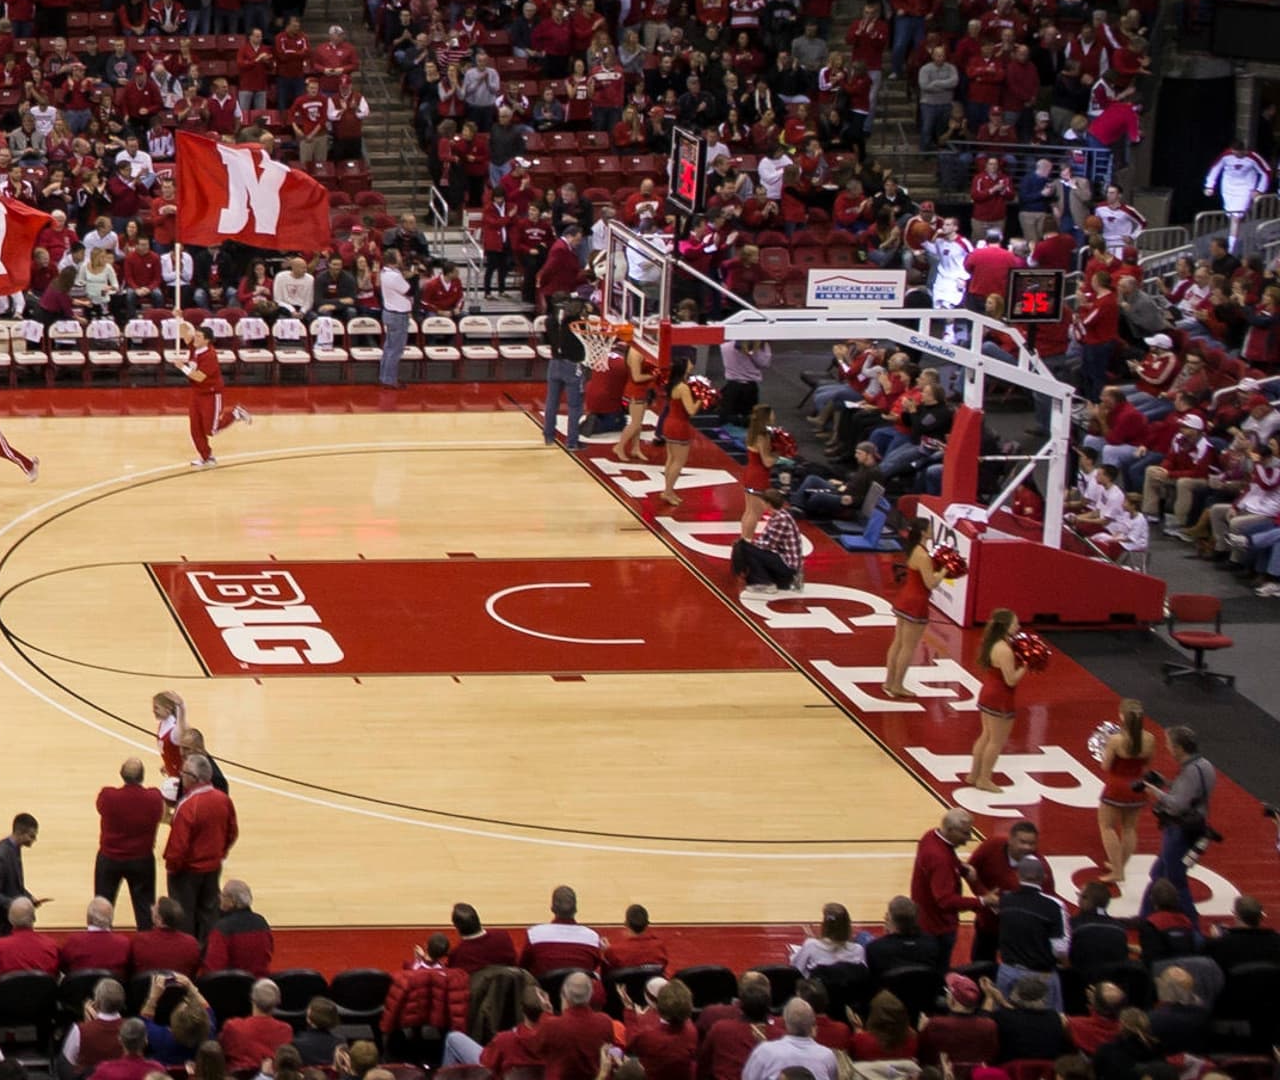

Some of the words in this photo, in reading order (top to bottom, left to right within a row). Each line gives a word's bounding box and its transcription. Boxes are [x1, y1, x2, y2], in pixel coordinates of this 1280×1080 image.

[216, 142, 291, 236] N
[815, 285, 861, 293] AMERICAN
[864, 285, 896, 293] FAMILY
[1021, 292, 1049, 313] 35
[909, 335, 956, 359] Schelde
